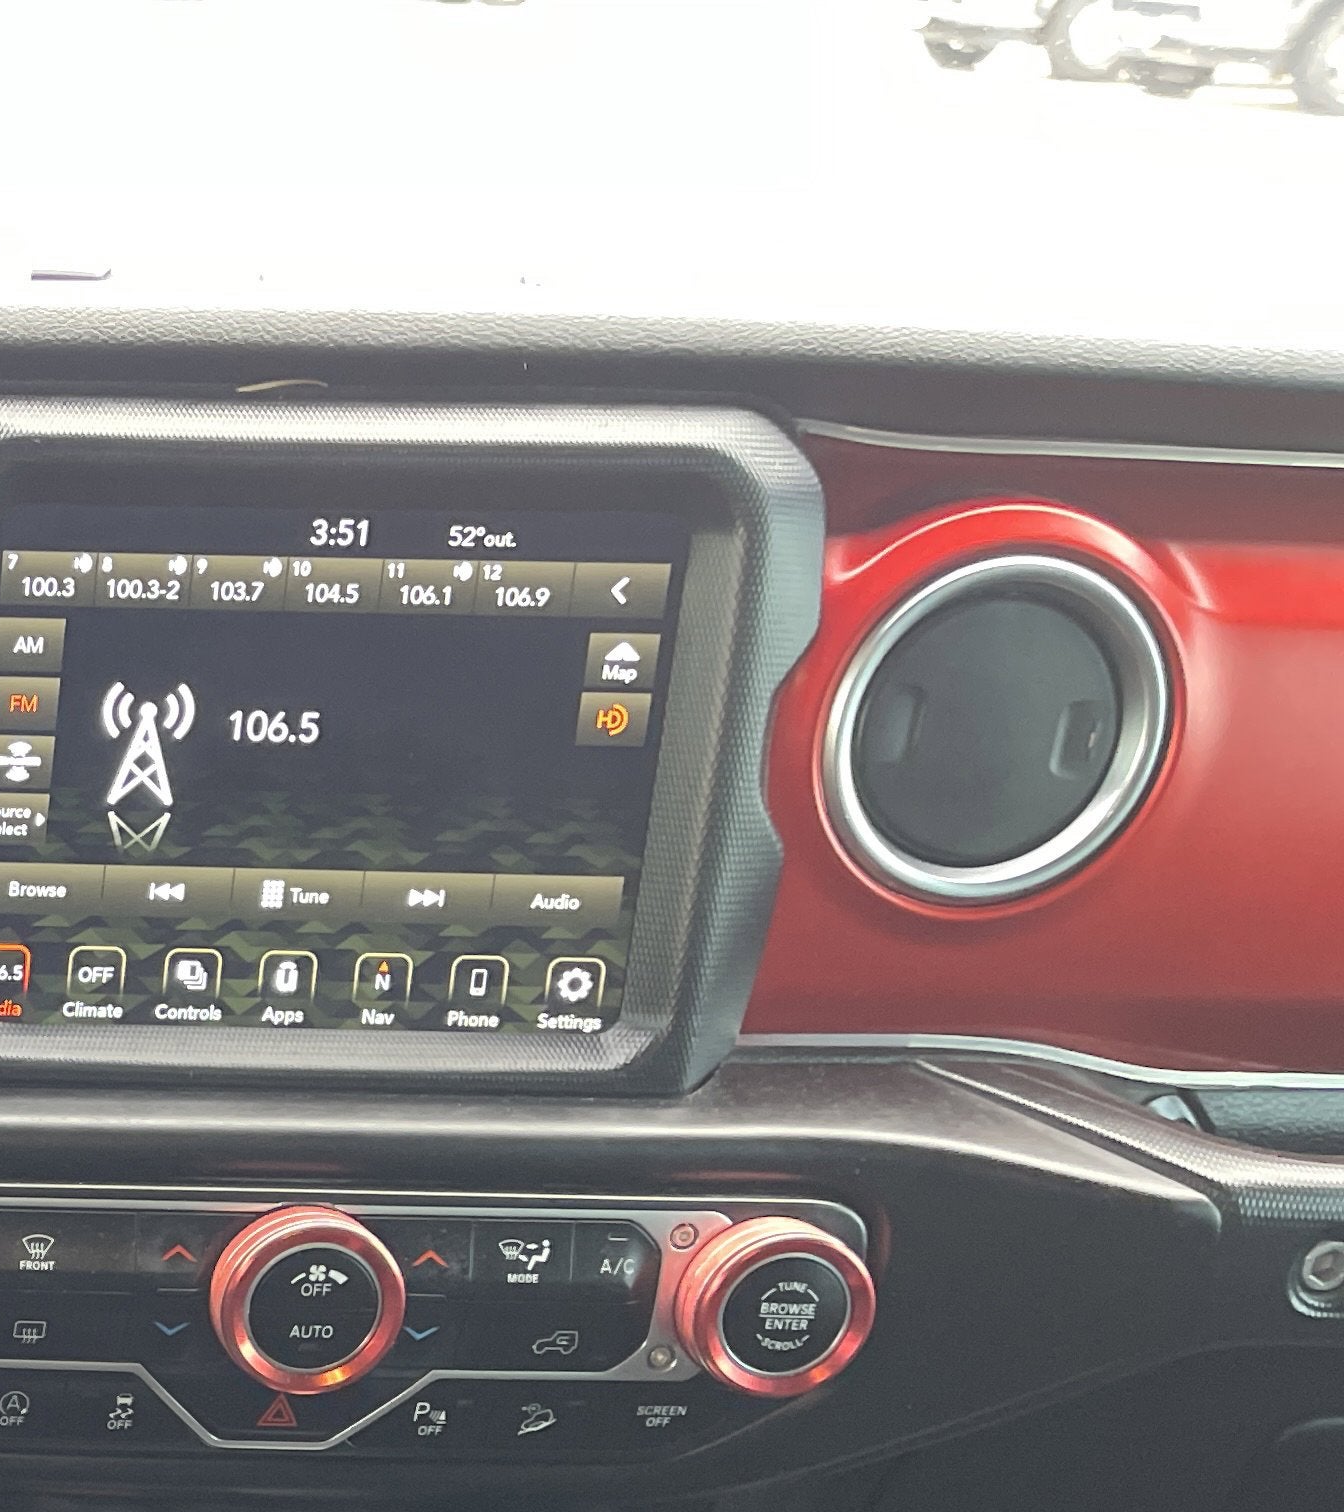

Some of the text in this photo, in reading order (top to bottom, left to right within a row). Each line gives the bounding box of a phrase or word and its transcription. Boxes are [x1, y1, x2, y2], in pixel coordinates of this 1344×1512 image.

[310, 519, 370, 546] 3:51
[7, 553, 18, 569] 7
[101, 556, 113, 573] 8
[196, 558, 208, 575] 9
[293, 561, 312, 577] 10
[388, 562, 406, 579] 11
[483, 564, 503, 581] 12
[22, 577, 76, 598] 100.3
[107, 578, 182, 601] 100.3-2
[210, 581, 264, 602] 103.7
[305, 583, 360, 604] 104.5
[400, 585, 452, 606] 106.1
[495, 587, 551, 608] 106.9
[13, 636, 44, 654] AM
[602, 665, 638, 684] Map
[9, 694, 39, 713] FM
[229, 709, 321, 744] 106.5
[8, 881, 67, 898] Browse
[290, 888, 329, 905] Tune
[530, 894, 581, 911] Audio
[78, 966, 114, 983] OFF
[62, 1002, 124, 1019] Climate
[155, 1004, 222, 1021] Controls
[262, 1006, 304, 1025] Apps
[362, 1009, 395, 1025] Nav
[447, 1011, 500, 1029] Phone
[537, 1013, 602, 1033] Settings
[19, 1260, 55, 1271] FRONT
[599, 1257, 635, 1276] A/C
[507, 1273, 539, 1284] MODE
[777, 1281, 808, 1293] TUNE
[300, 1283, 332, 1297] OFF
[760, 1302, 817, 1315] BROWSE
[289, 1325, 334, 1339] AUTO
[764, 1319, 809, 1331] ENTER
[761, 1337, 804, 1351] SCROLL
[636, 1405, 687, 1417] SCREEN
[0, 1415, 24, 1427] OFF
[107, 1418, 133, 1430] OFF
[645, 1416, 671, 1428] OFF
[417, 1426, 442, 1436] OFF
